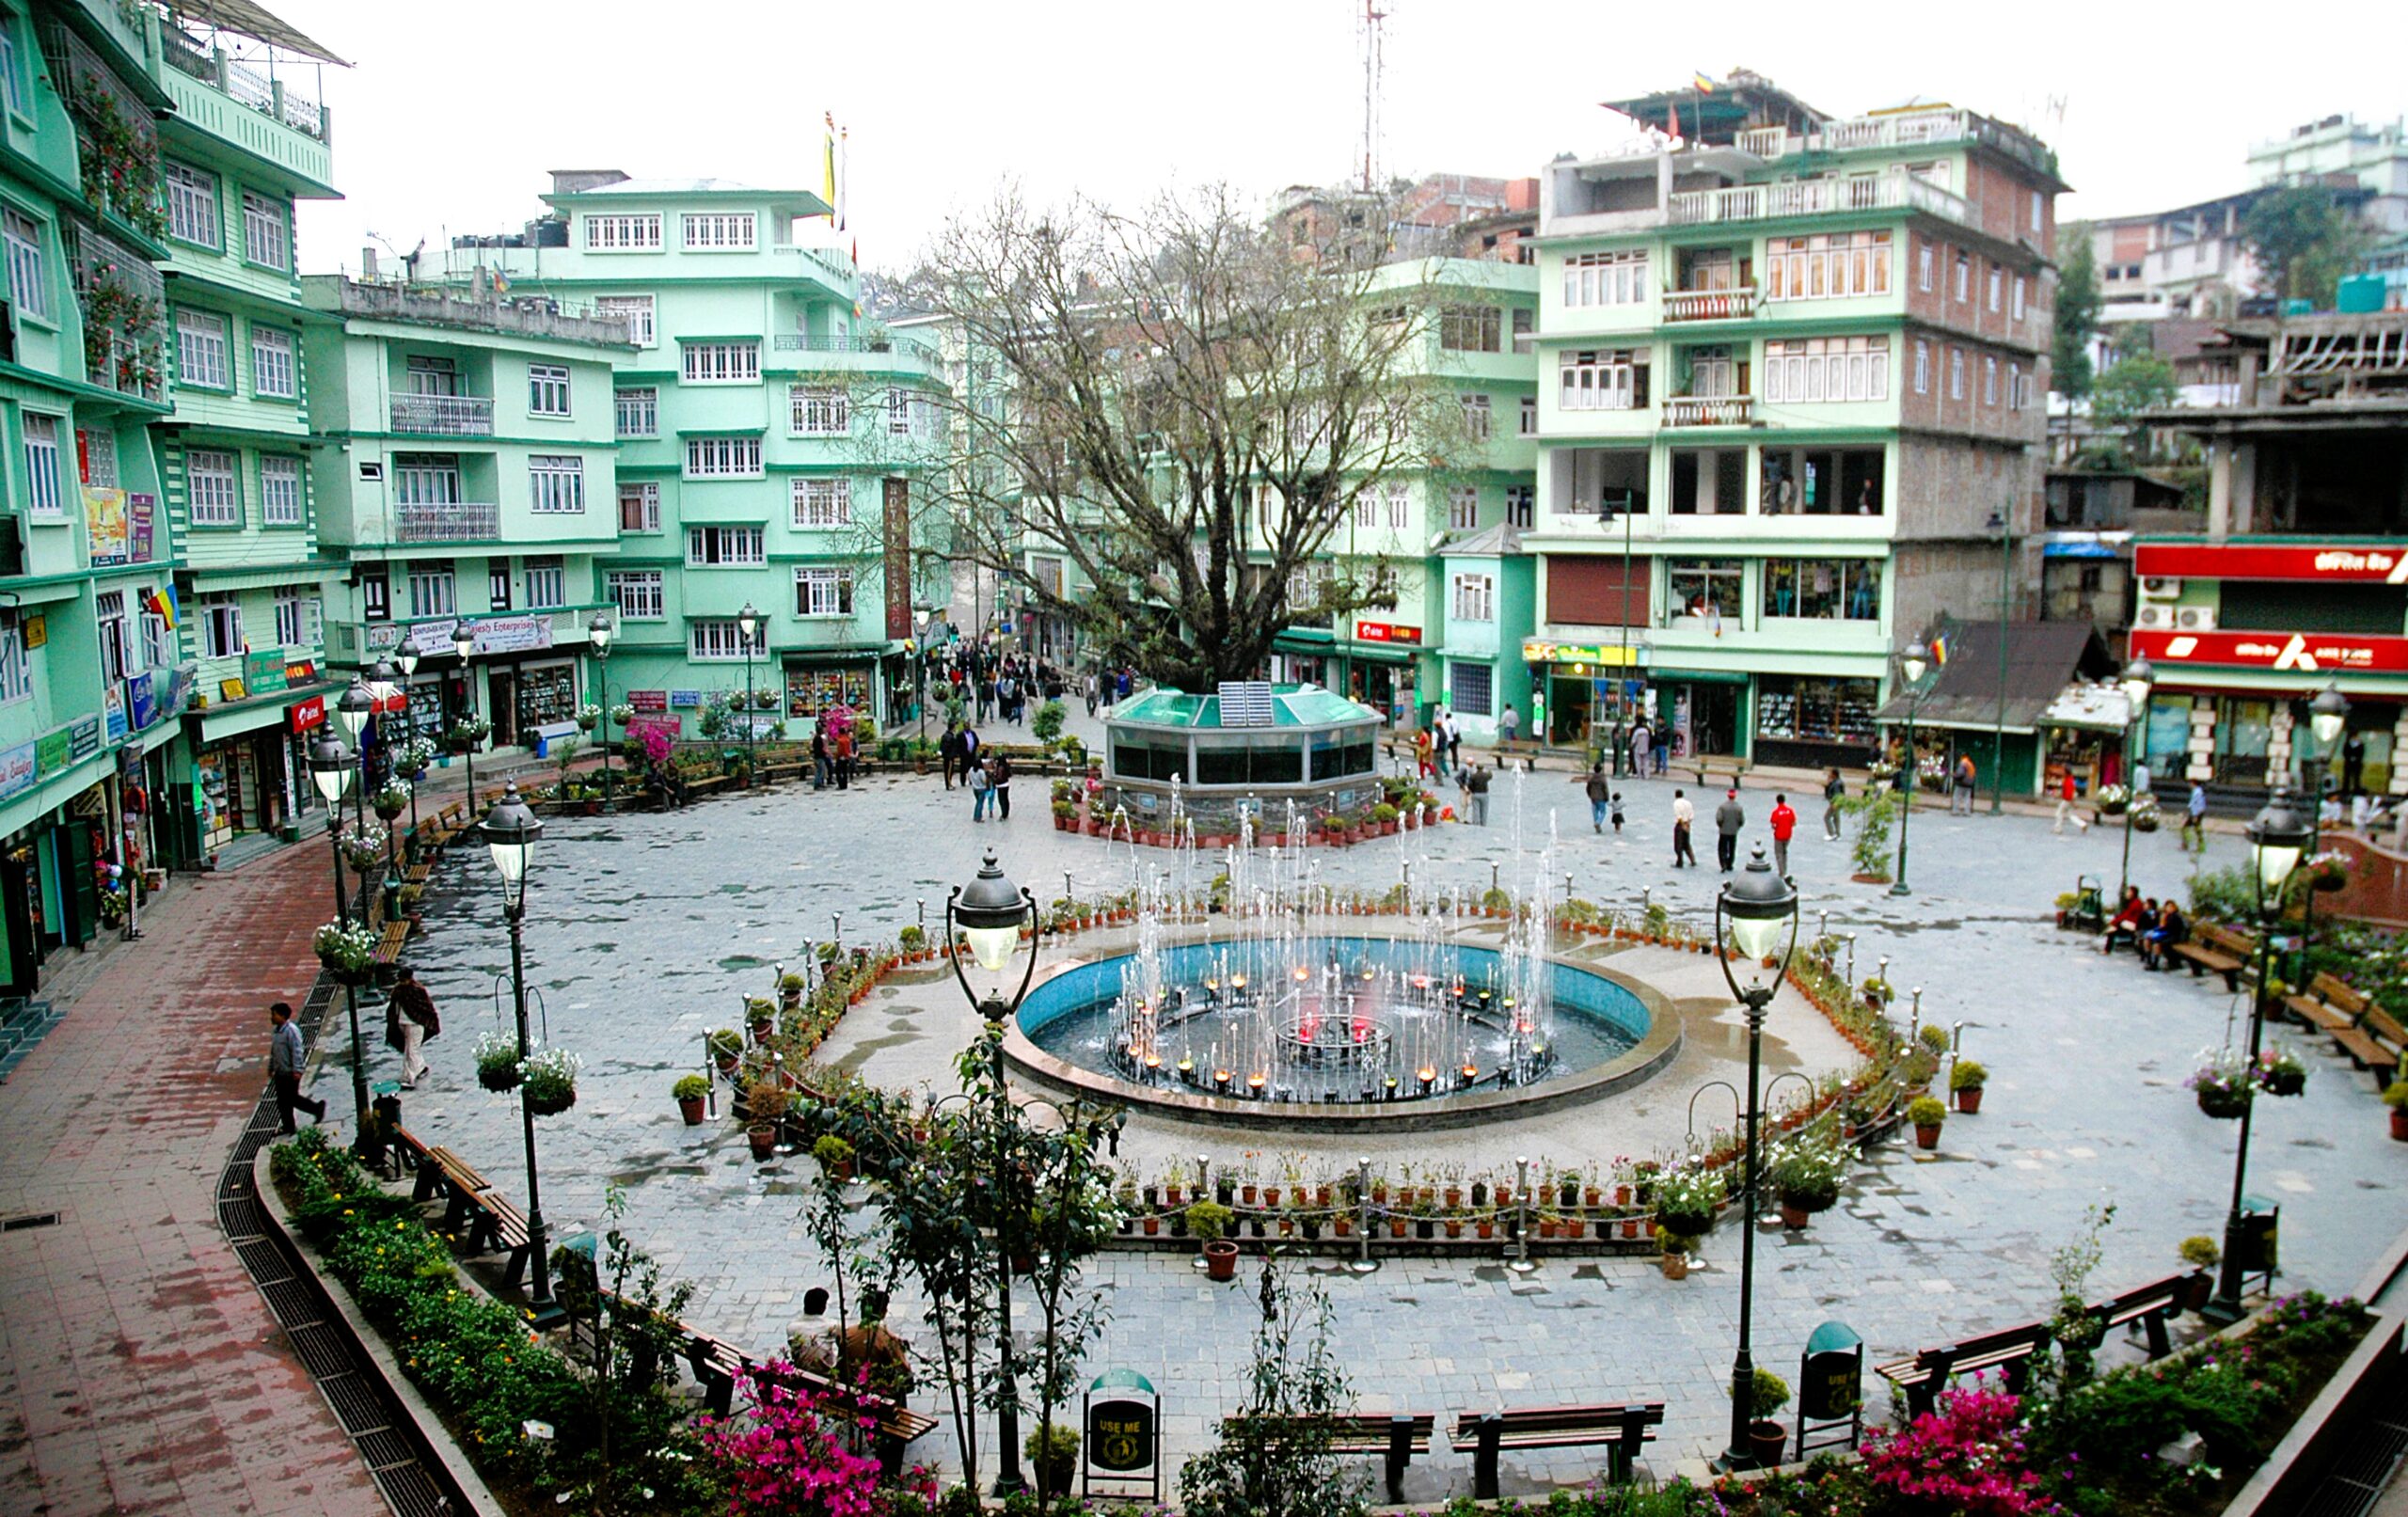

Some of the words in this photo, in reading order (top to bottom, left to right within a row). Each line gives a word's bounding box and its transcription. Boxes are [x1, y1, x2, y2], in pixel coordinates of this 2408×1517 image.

[889, 483, 898, 546] HOTEL
[494, 620, 534, 634] Enterprises
[1100, 1419, 1121, 1432] USE
[1124, 1421, 1140, 1433] ME
